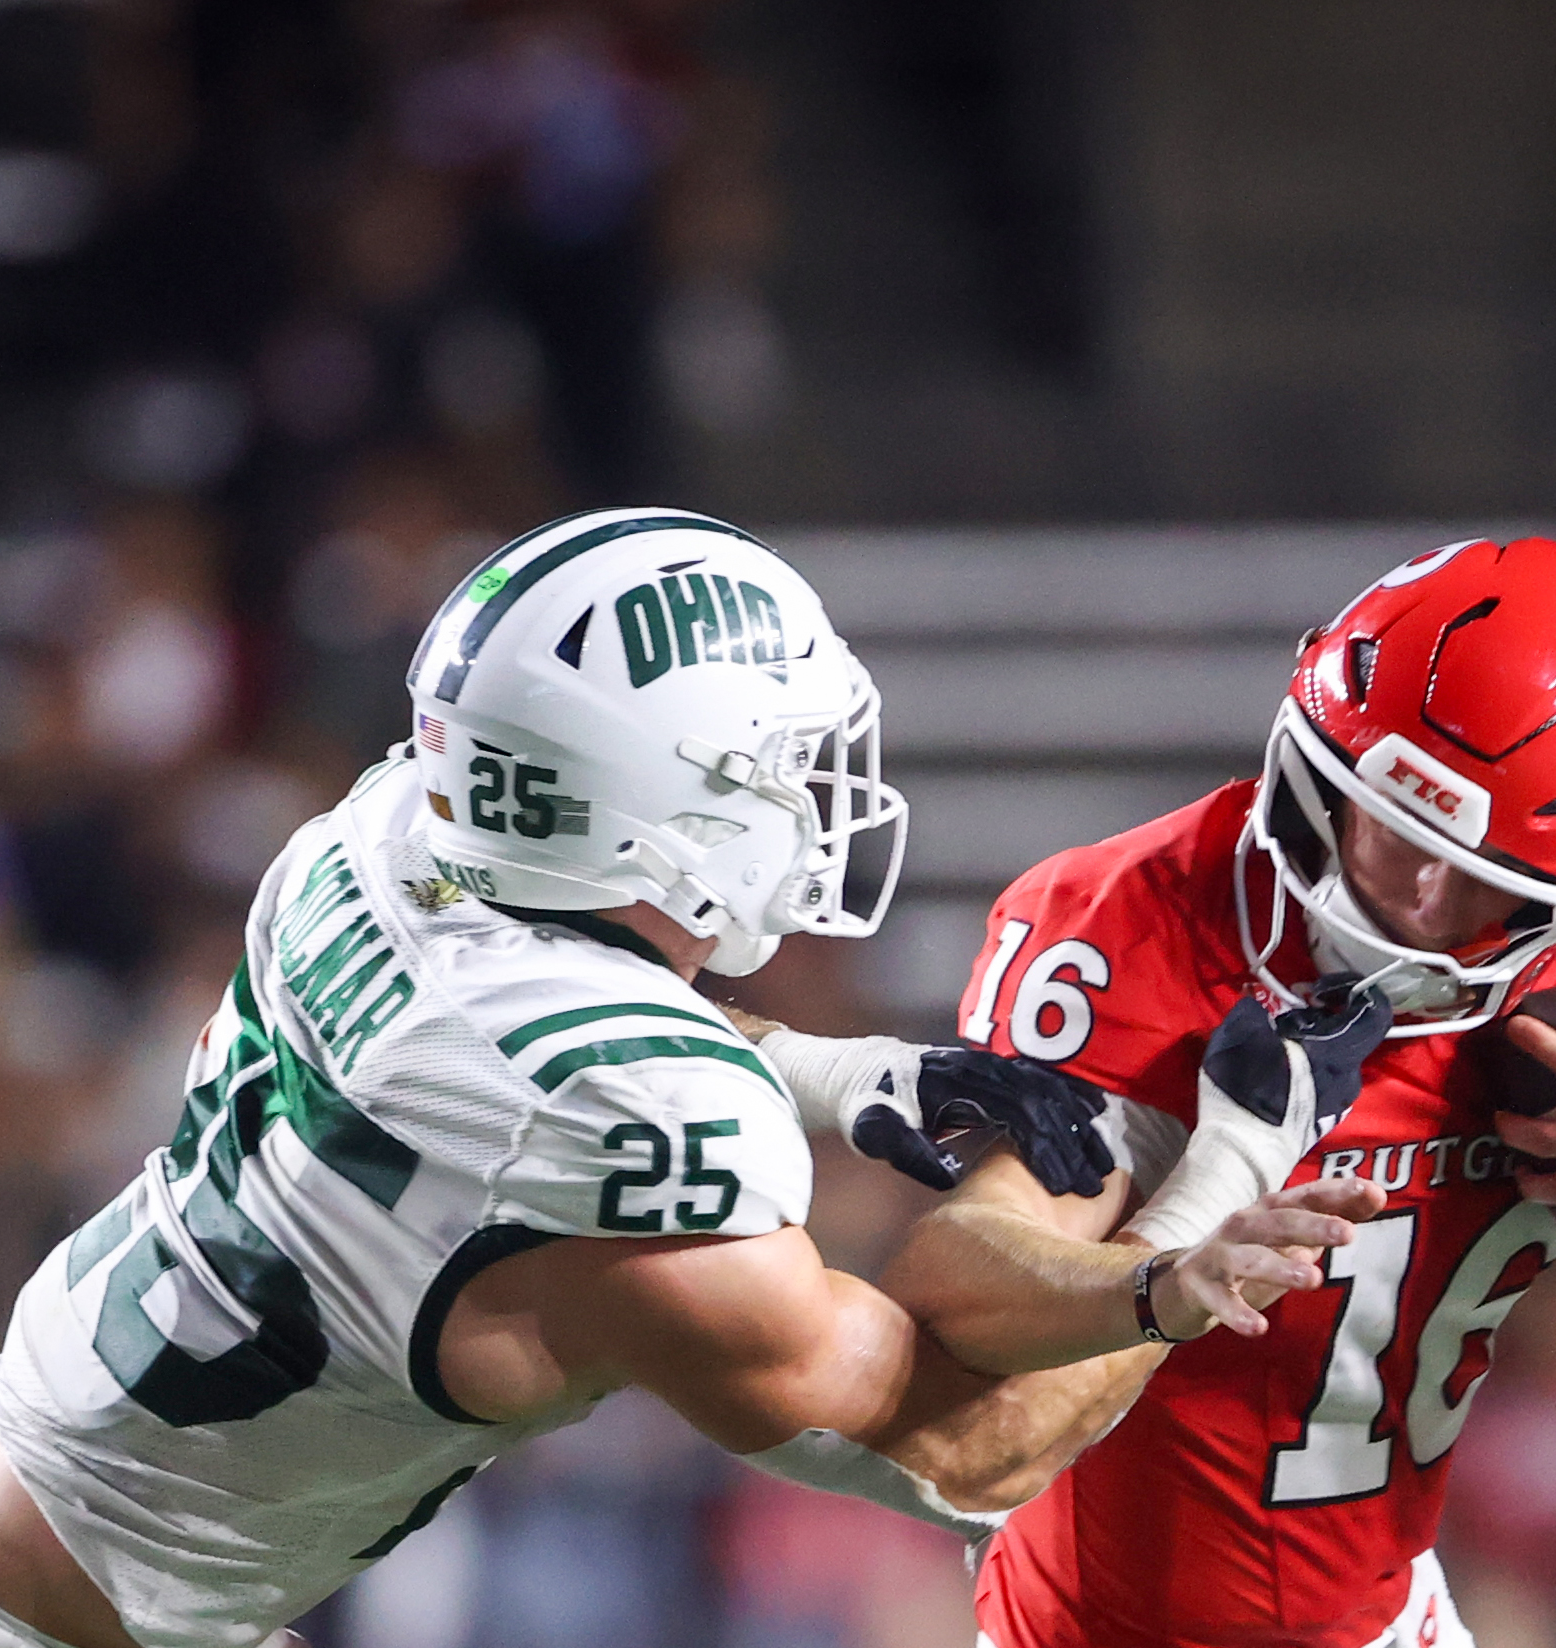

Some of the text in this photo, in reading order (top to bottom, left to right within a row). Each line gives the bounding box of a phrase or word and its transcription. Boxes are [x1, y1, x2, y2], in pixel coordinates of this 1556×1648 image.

[615, 573, 788, 689] OHIO
[469, 756, 558, 840] 25
[963, 918, 1112, 1063] 16
[598, 1119, 741, 1232] 25
[1319, 1133, 1519, 1192] RUTG
